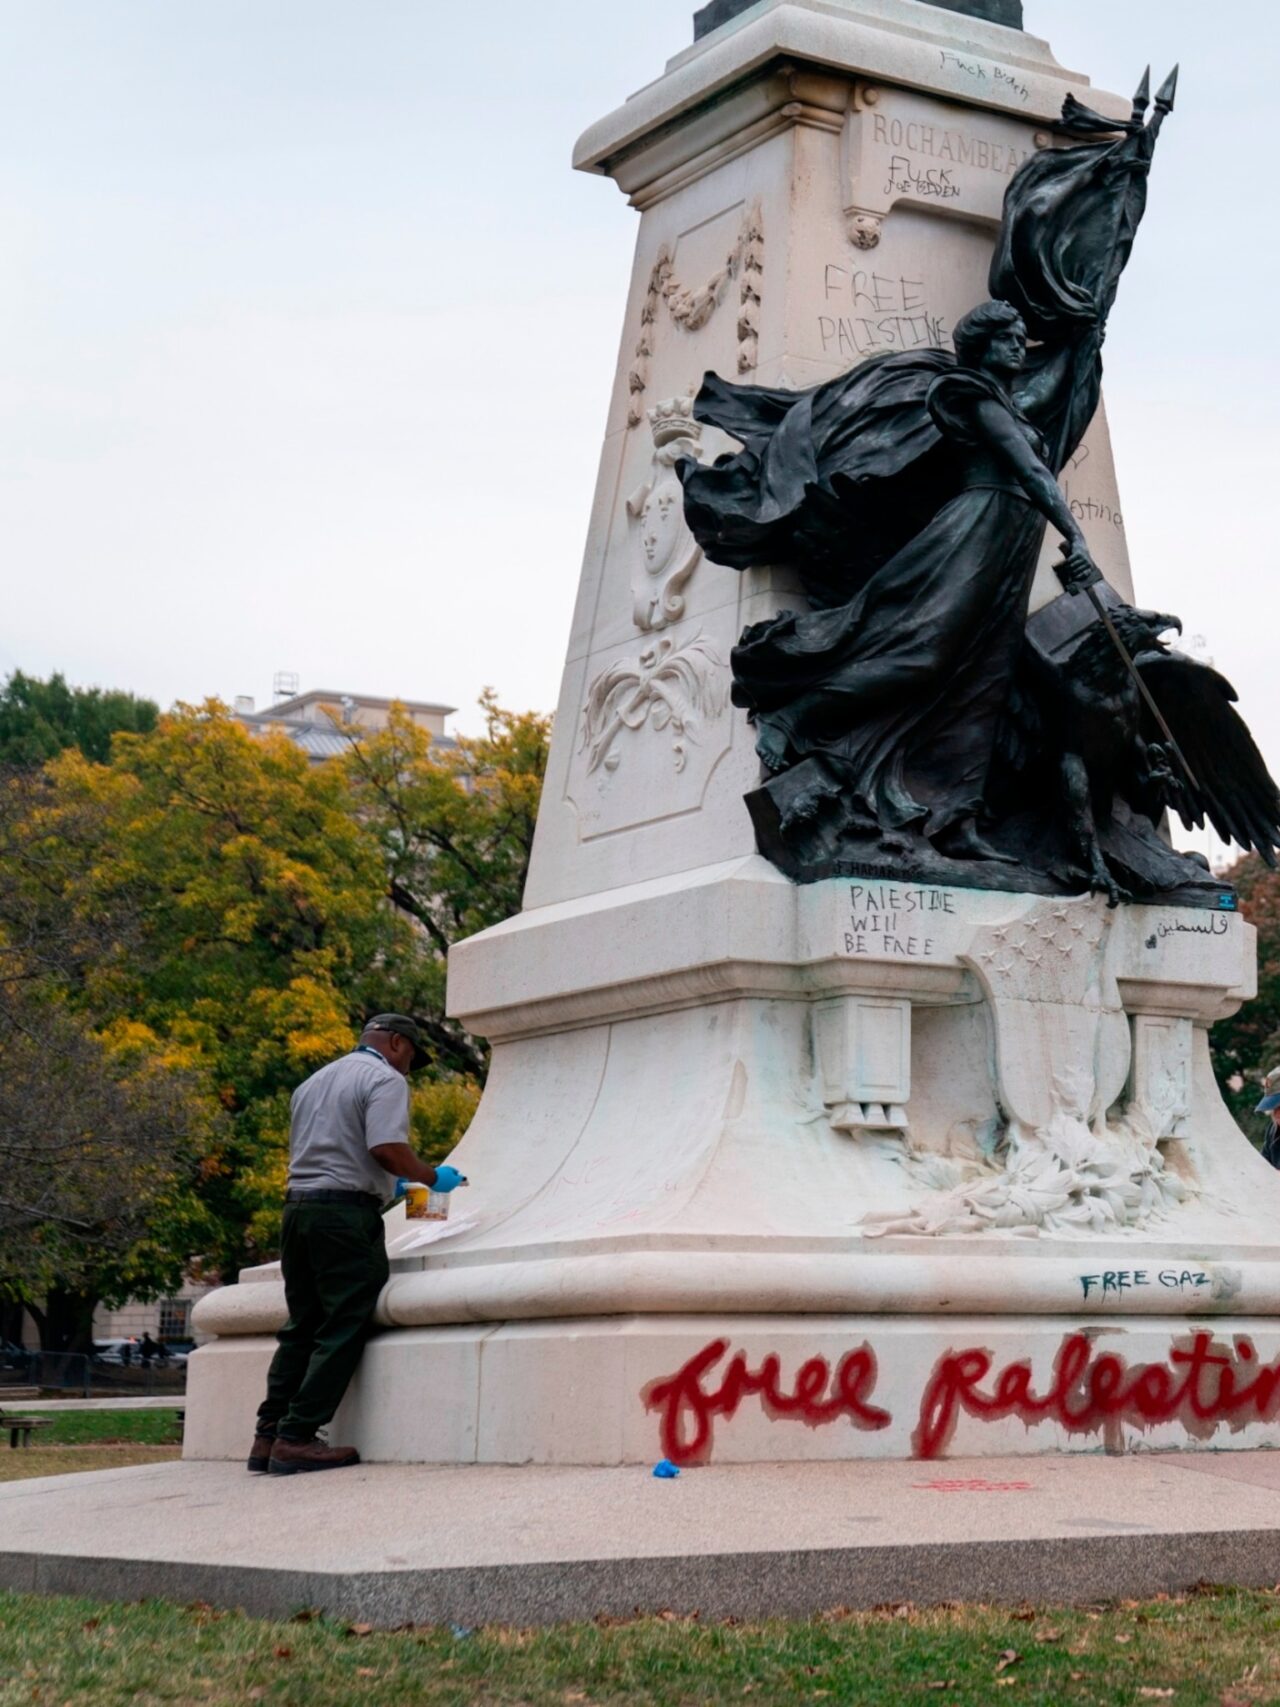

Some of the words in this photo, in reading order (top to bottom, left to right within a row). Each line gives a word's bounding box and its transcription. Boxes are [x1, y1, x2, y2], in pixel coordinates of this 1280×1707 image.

[888, 155, 953, 186] FUCK
[824, 263, 926, 313] FREE
[1157, 912, 1229, 938] فلسطين
[844, 932, 868, 953] BE
[883, 935, 936, 956] FREE
[1080, 1270, 1149, 1300] FREE
[646, 1337, 893, 1467] free
